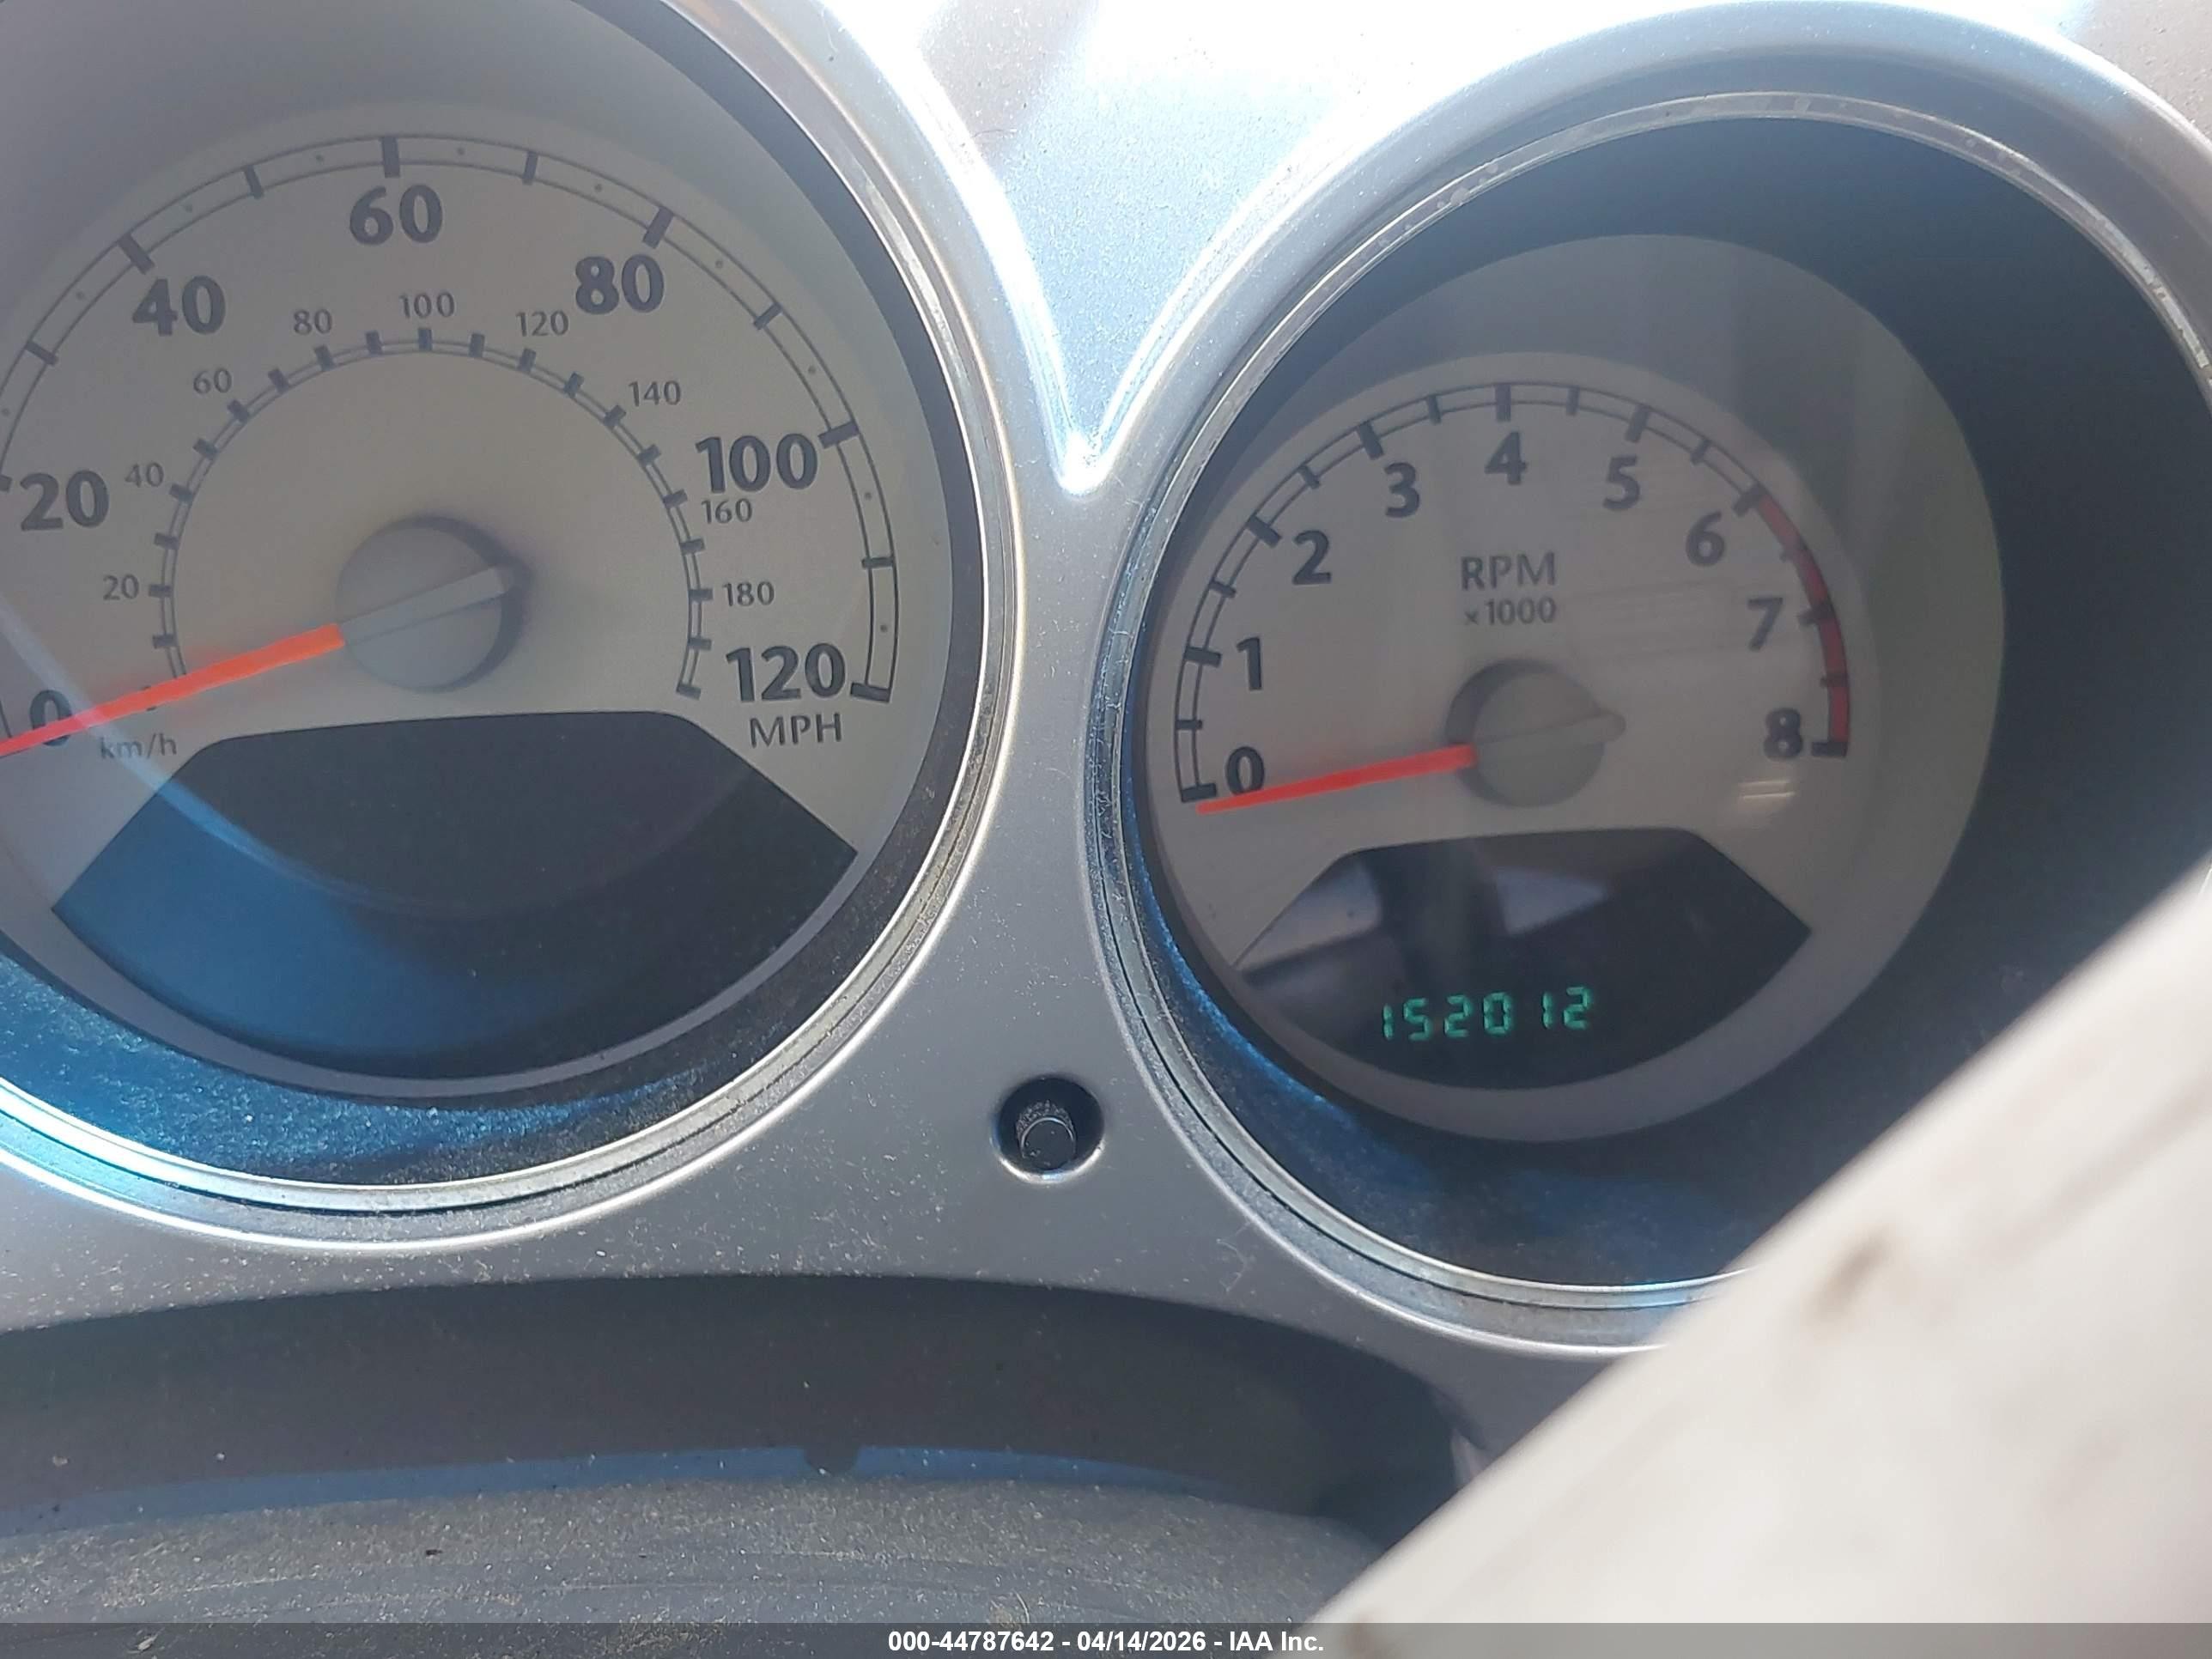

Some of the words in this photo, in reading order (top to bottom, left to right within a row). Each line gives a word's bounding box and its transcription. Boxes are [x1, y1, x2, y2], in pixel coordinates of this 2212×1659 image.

[349, 184, 443, 246] 60
[131, 276, 226, 336] 40
[399, 292, 455, 319] 100
[574, 254, 665, 314] 80
[293, 309, 333, 335] 80
[515, 310, 569, 337] 120
[192, 368, 233, 394] 60
[629, 380, 682, 407] 140
[125, 463, 164, 488] 40
[696, 433, 817, 494] 100
[1485, 432, 1527, 485] 4
[1602, 456, 1641, 511] 5
[21, 470, 110, 532] 20
[701, 499, 753, 524] 160
[1384, 462, 1420, 518] 3
[1291, 530, 1332, 586] 2
[1686, 512, 1726, 567] 6
[102, 574, 139, 600] 20
[723, 581, 775, 606] 180
[1461, 552, 1556, 591] RPM
[1465, 597, 1556, 626] x1000
[1747, 597, 1784, 651] 7
[726, 643, 846, 702] 120
[1237, 636, 1262, 690] 1
[29, 690, 72, 746] 0
[749, 713, 842, 748] MPH
[1764, 708, 1803, 761] 8
[100, 732, 177, 761] km/h
[1225, 746, 1265, 795] 0
[1382, 986, 1593, 1042] 152012
